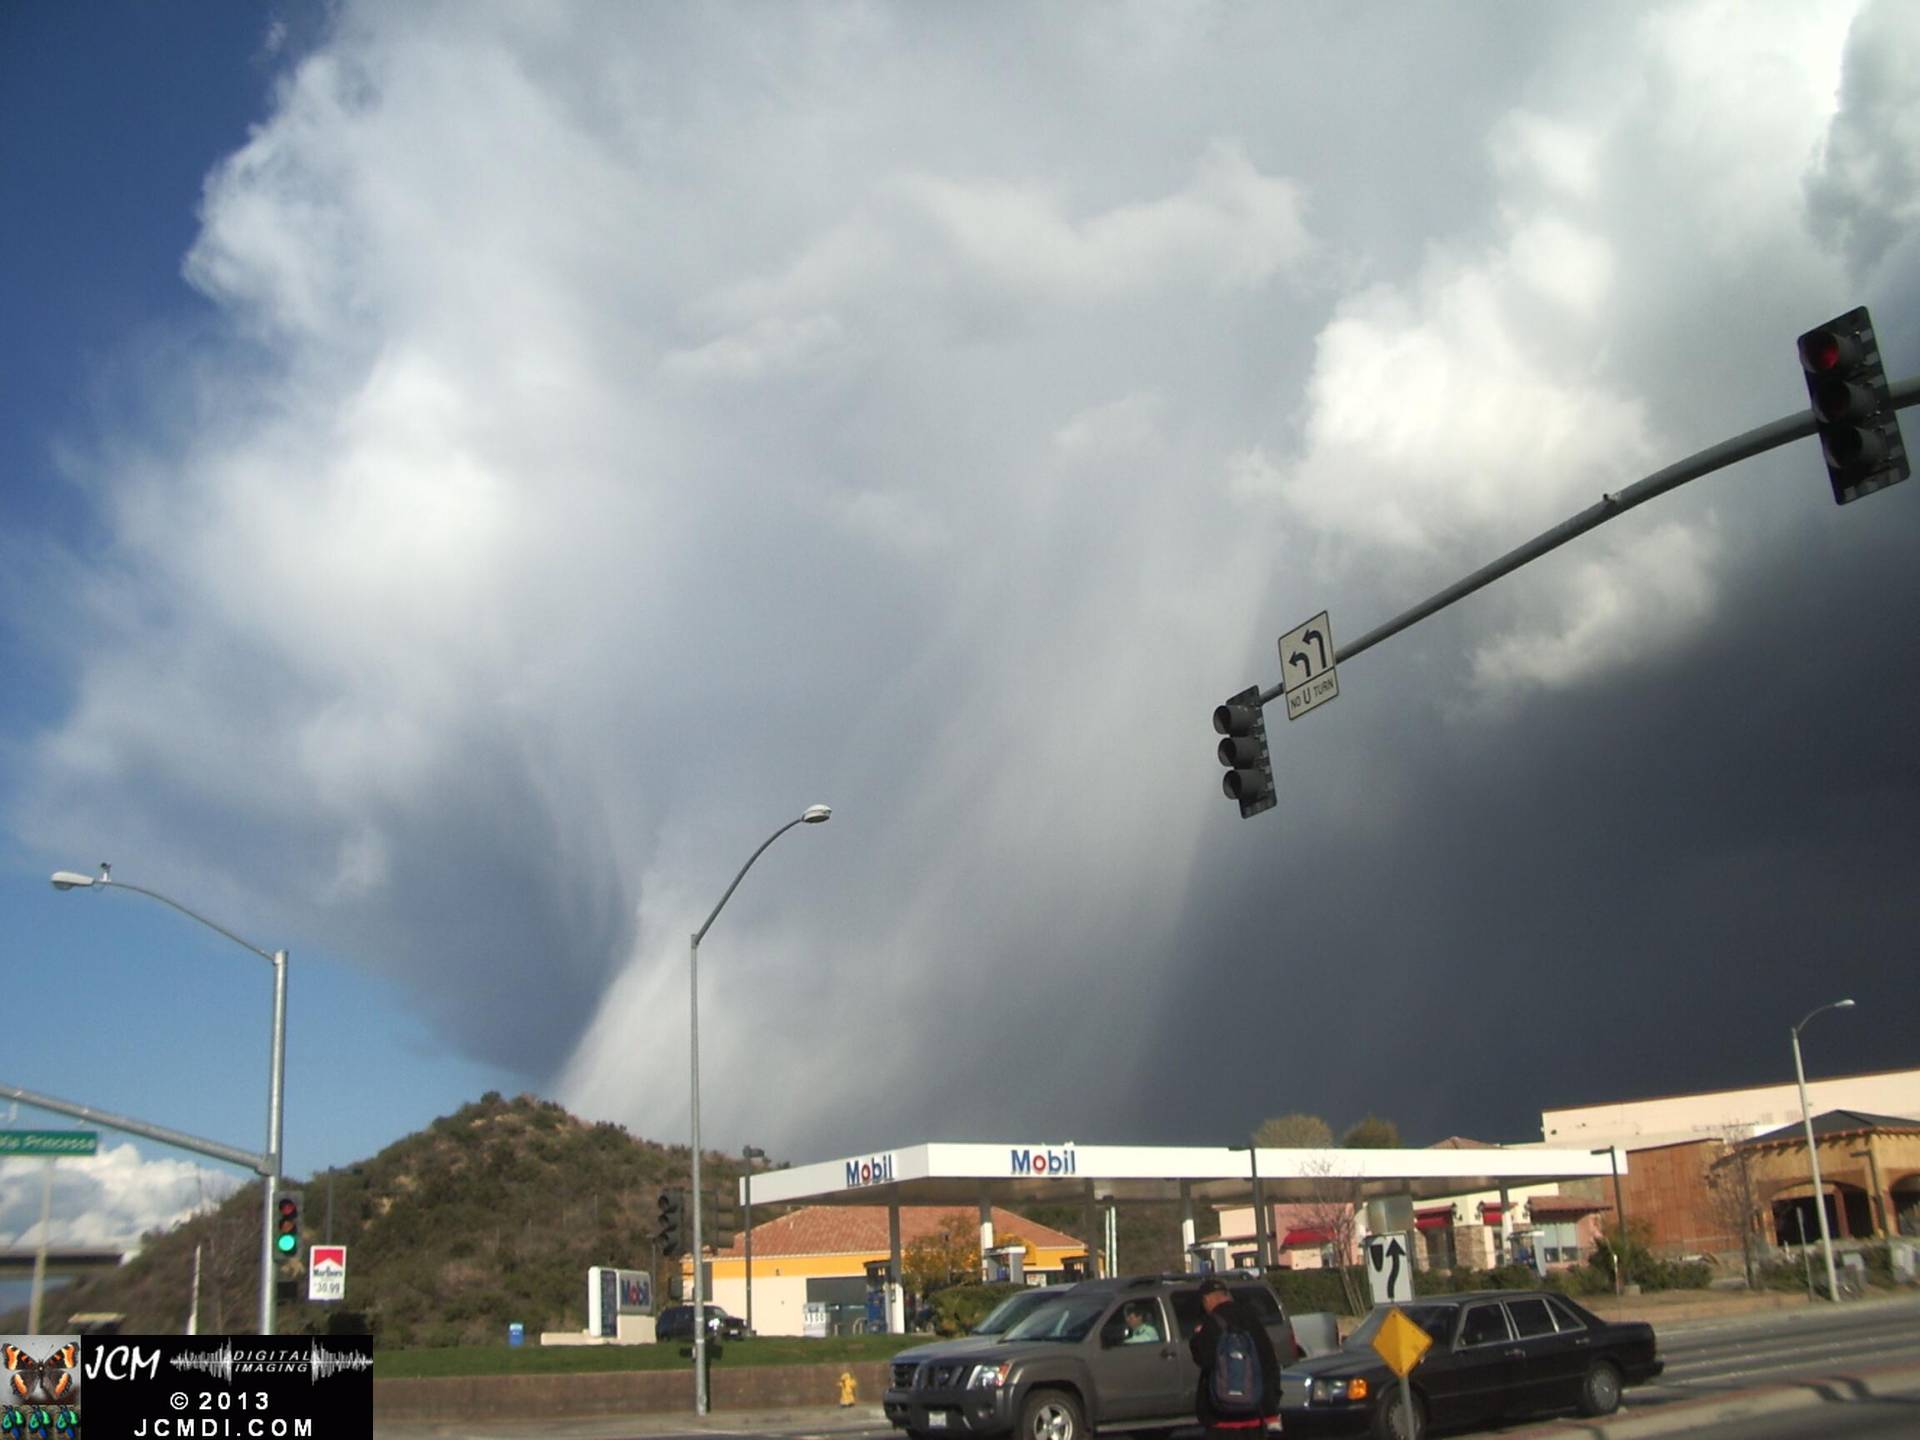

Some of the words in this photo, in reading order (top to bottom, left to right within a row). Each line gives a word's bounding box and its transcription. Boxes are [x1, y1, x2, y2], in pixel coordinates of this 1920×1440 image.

[1290, 695, 1301, 710] NO
[1302, 687, 1311, 704] U
[1313, 678, 1334, 697] TURN
[846, 1154, 893, 1188] Mobil
[1010, 1150, 1076, 1176] Mobil
[621, 1280, 649, 1306] Mobil
